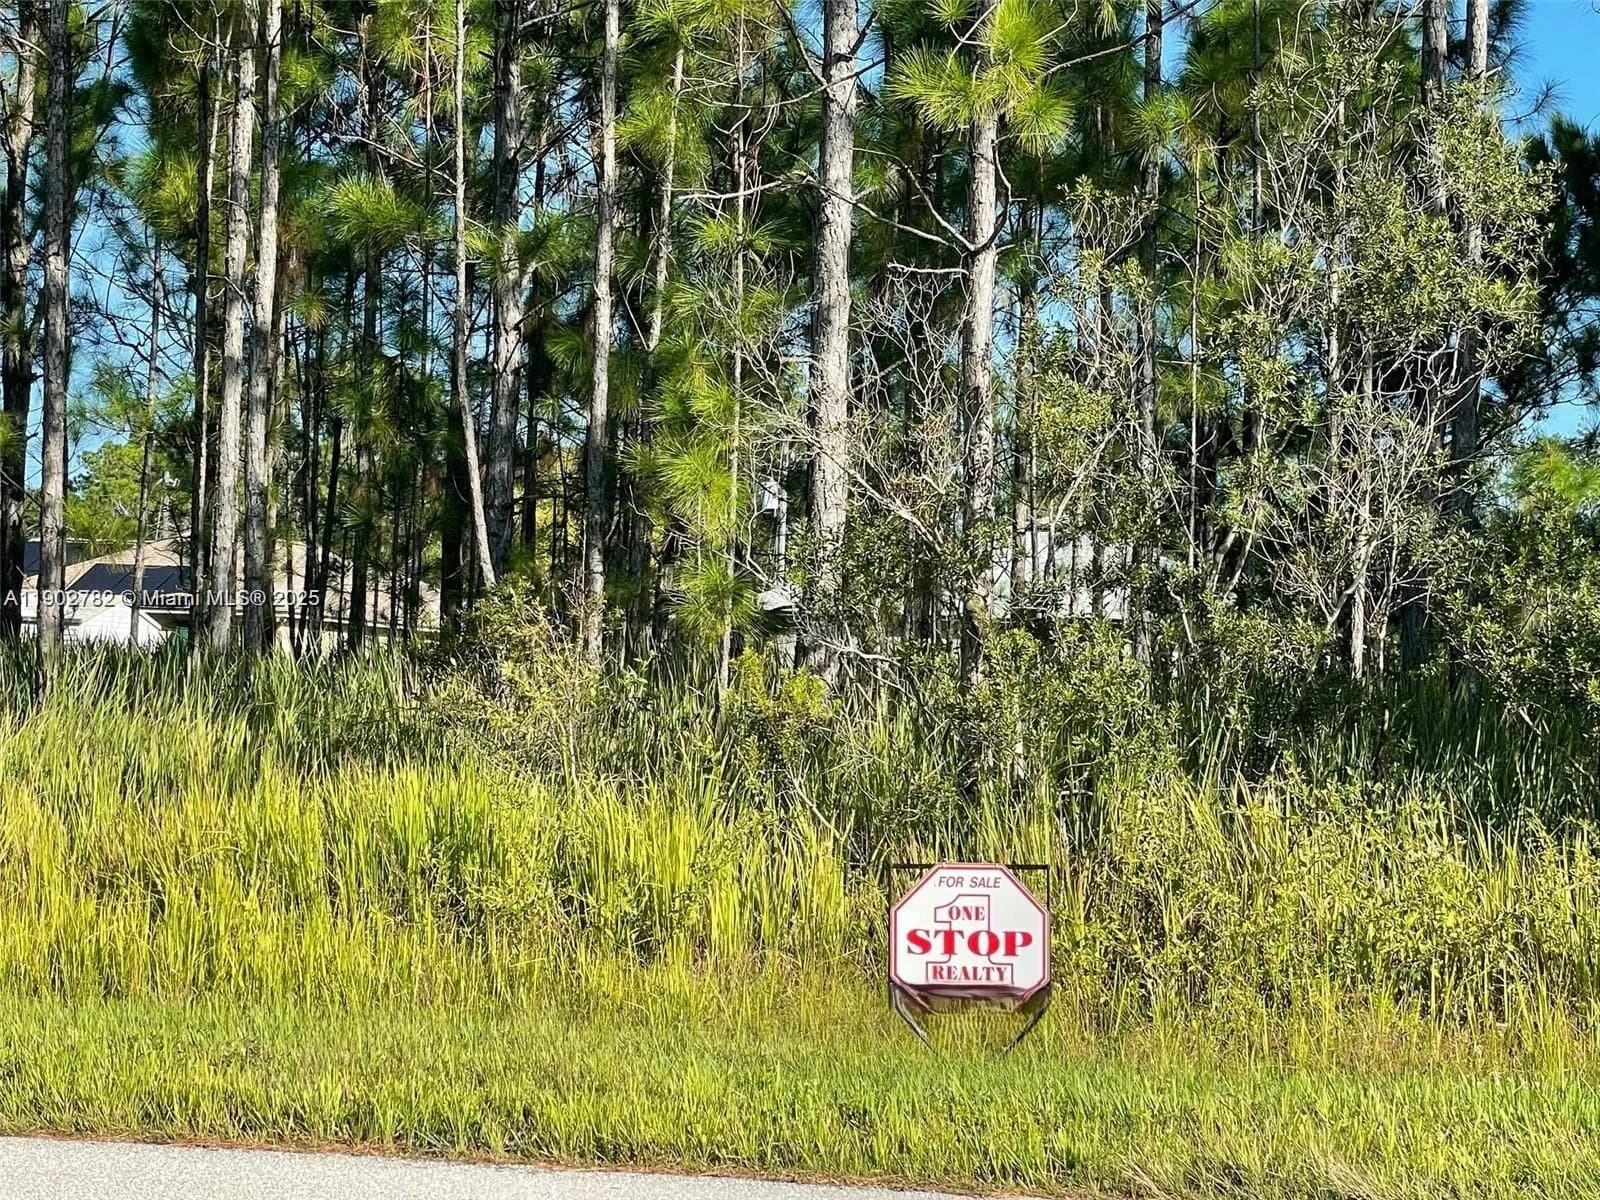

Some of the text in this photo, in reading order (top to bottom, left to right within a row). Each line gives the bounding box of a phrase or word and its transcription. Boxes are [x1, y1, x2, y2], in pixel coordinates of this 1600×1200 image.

[938, 876, 1001, 889] FOR SALE
[948, 905, 985, 921] ONE
[906, 928, 1033, 957] STOP
[932, 965, 1007, 982] REALTY
